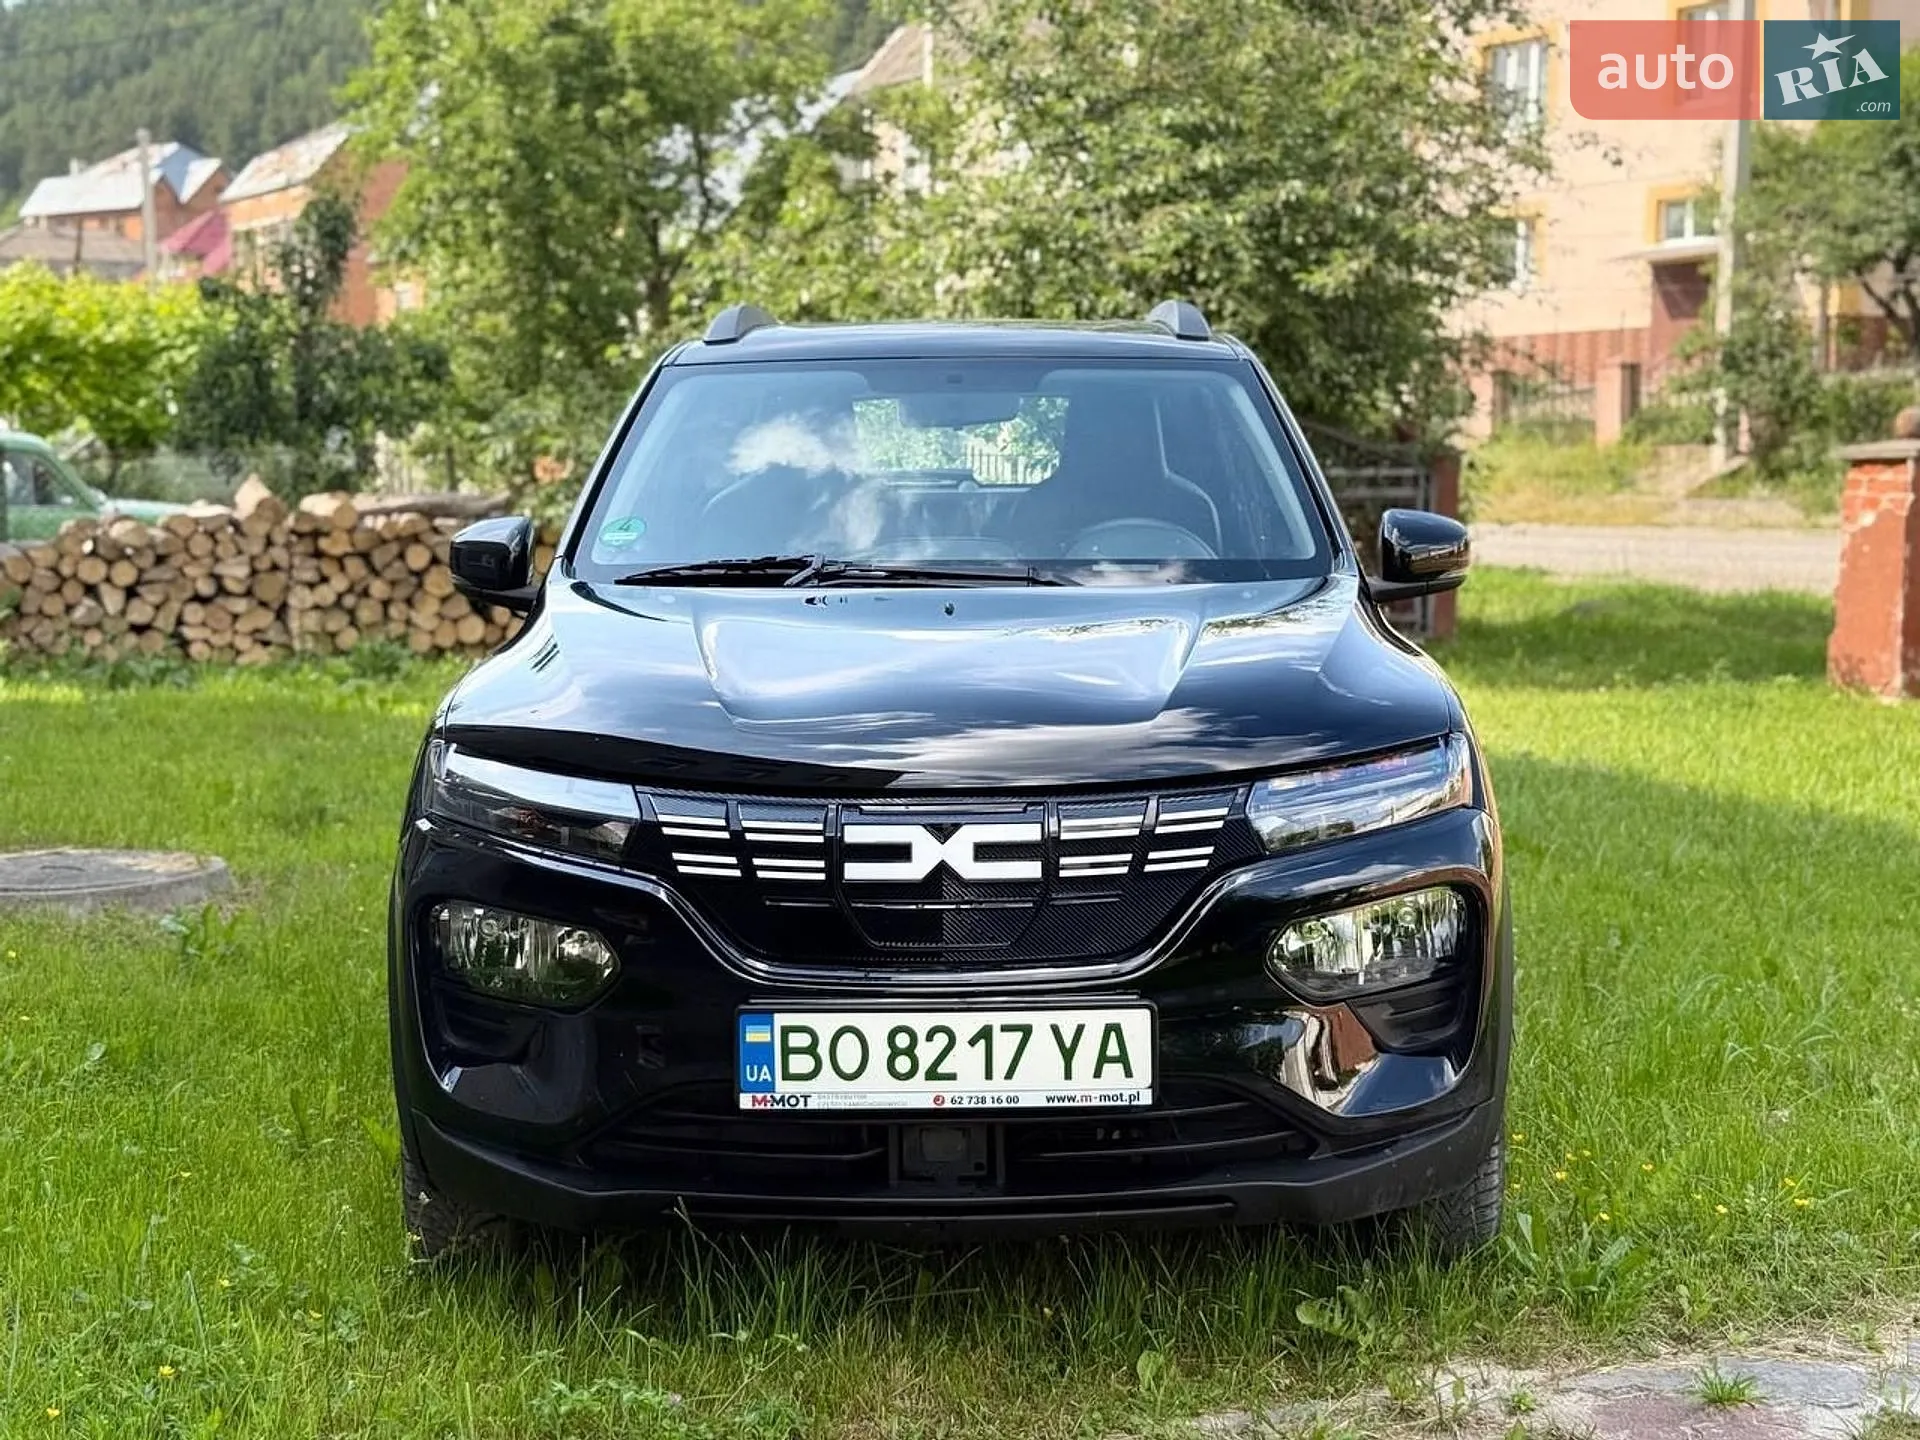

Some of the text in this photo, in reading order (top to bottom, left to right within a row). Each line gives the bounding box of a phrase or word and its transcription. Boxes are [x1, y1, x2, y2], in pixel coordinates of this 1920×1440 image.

[780, 1022, 1134, 1081] BO 8217 YA
[746, 1064, 772, 1082] UA
[950, 1094, 1020, 1105] 62 738 16 00
[1045, 1091, 1141, 1104] www.m-mot.pl
